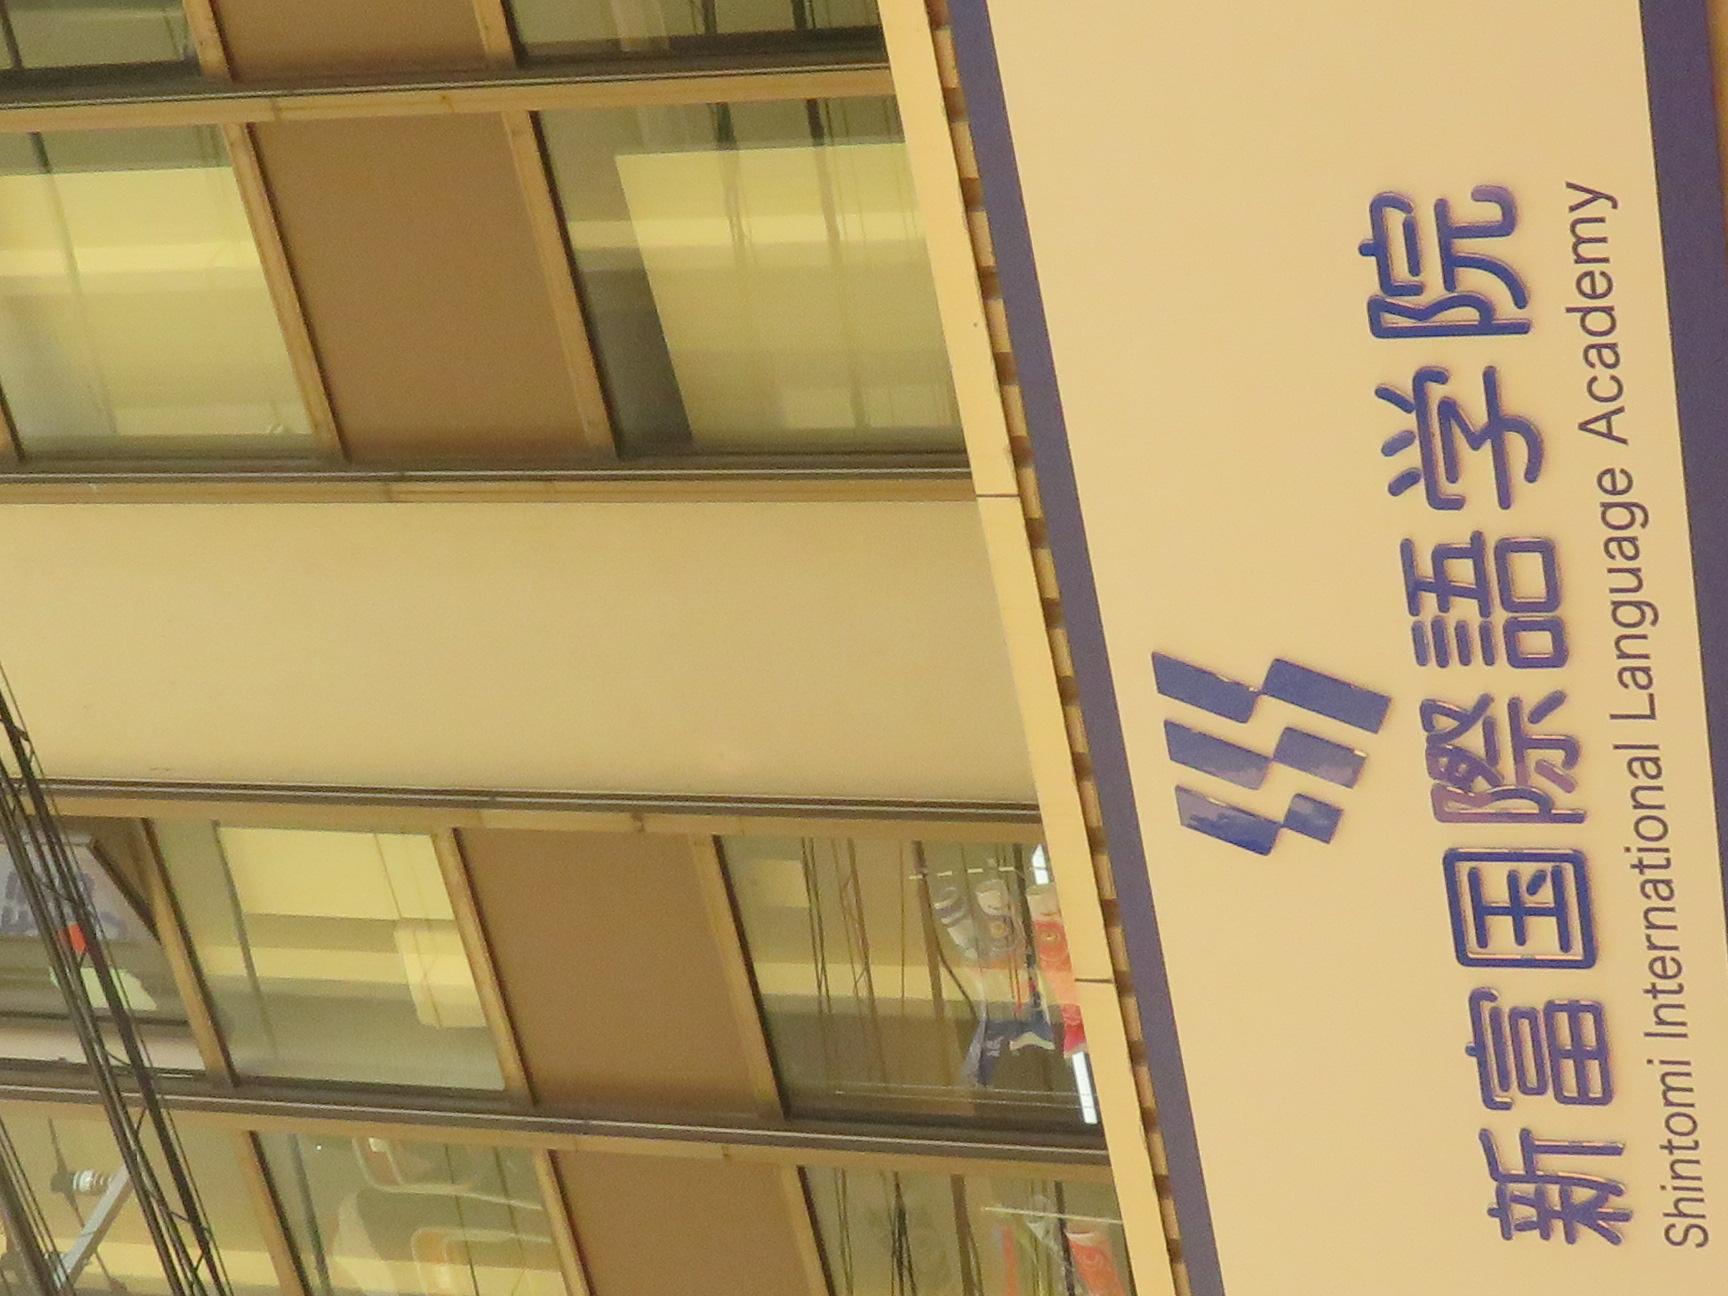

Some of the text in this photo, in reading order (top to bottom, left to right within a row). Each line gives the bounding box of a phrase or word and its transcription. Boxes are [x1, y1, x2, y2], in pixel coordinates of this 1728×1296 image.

[1357, 184, 1633, 1249] 新富国際語学院
[1565, 181, 1710, 1249] Shintomi International Language Academy
